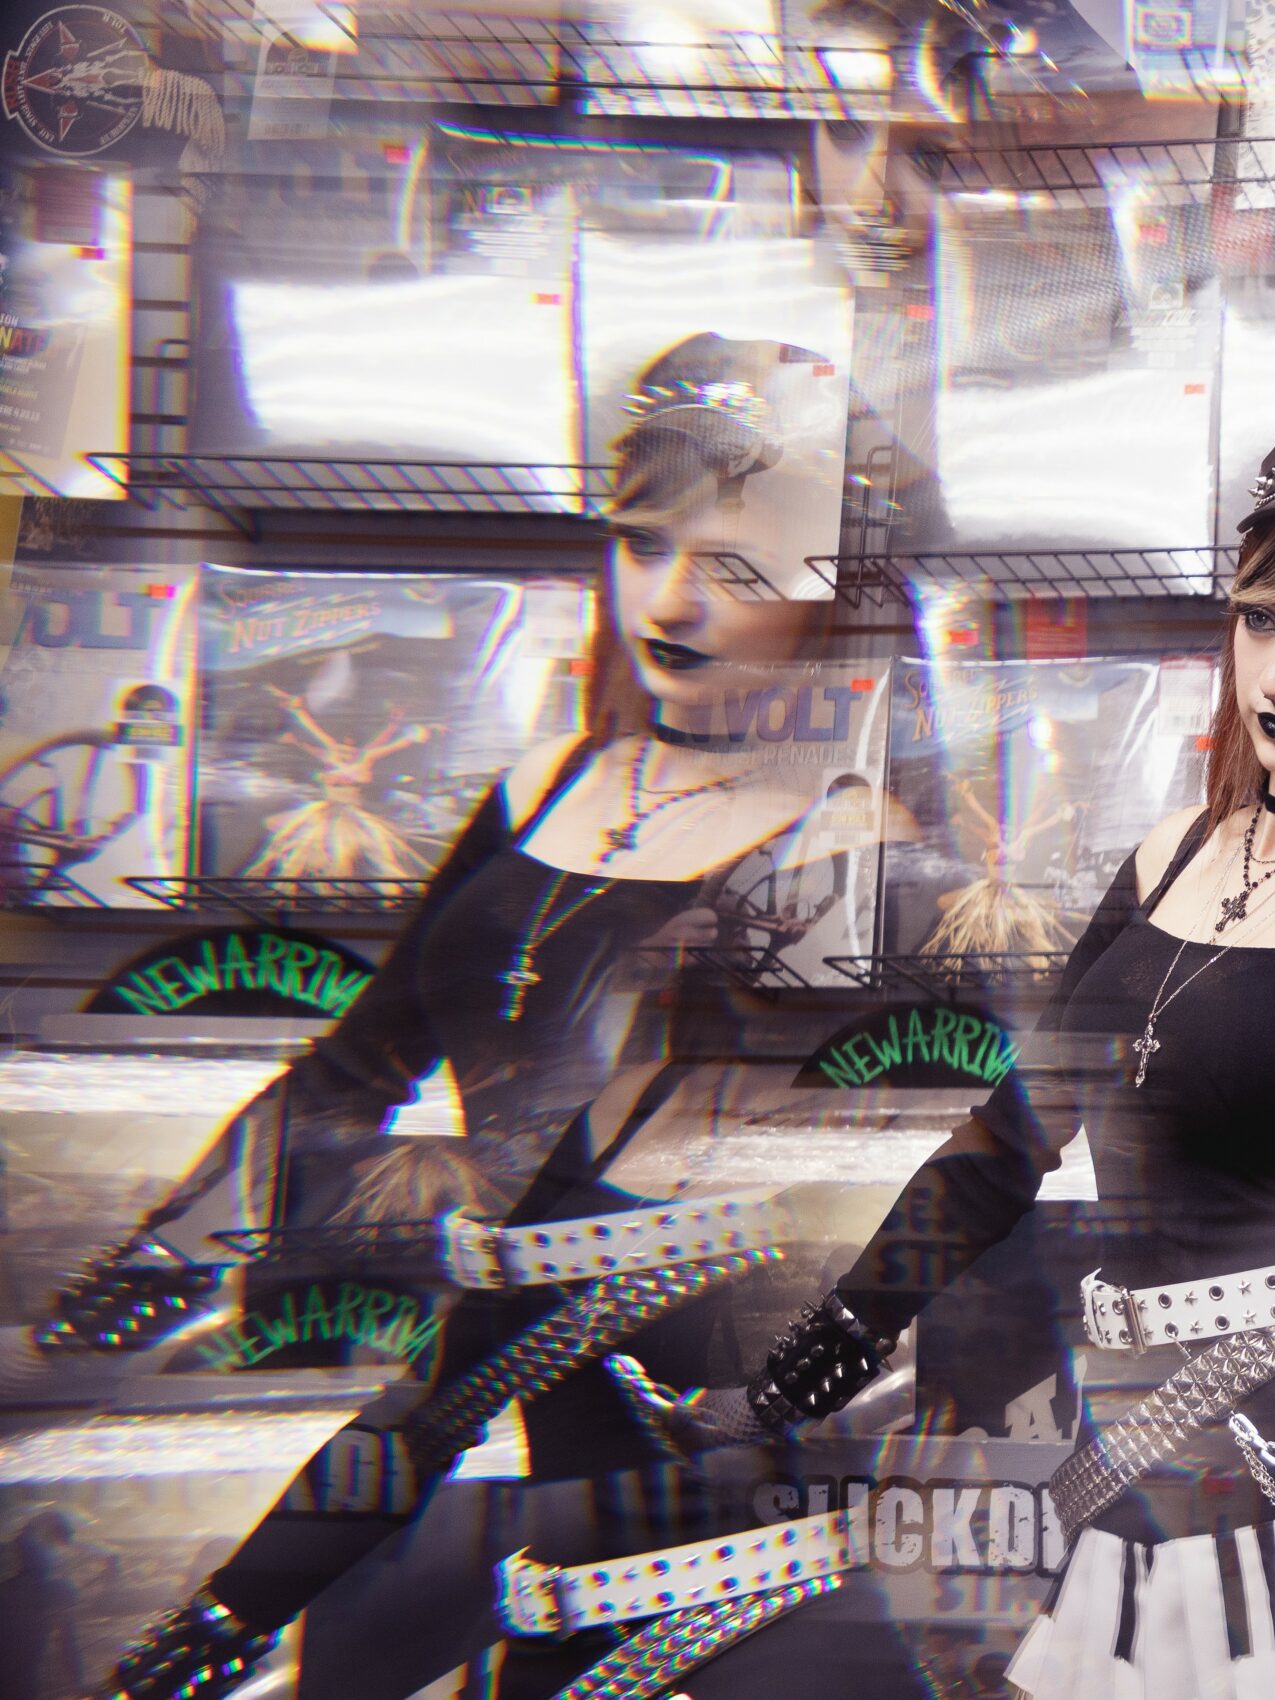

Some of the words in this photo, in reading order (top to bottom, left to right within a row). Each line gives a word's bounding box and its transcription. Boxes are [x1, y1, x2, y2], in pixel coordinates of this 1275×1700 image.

[292, 602, 383, 637] ZIPPERS
[113, 939, 219, 1016] NEW
[216, 933, 376, 1018] ARRIVA
[819, 1014, 903, 1089] NEW
[900, 1007, 1023, 1087] ARRIVA
